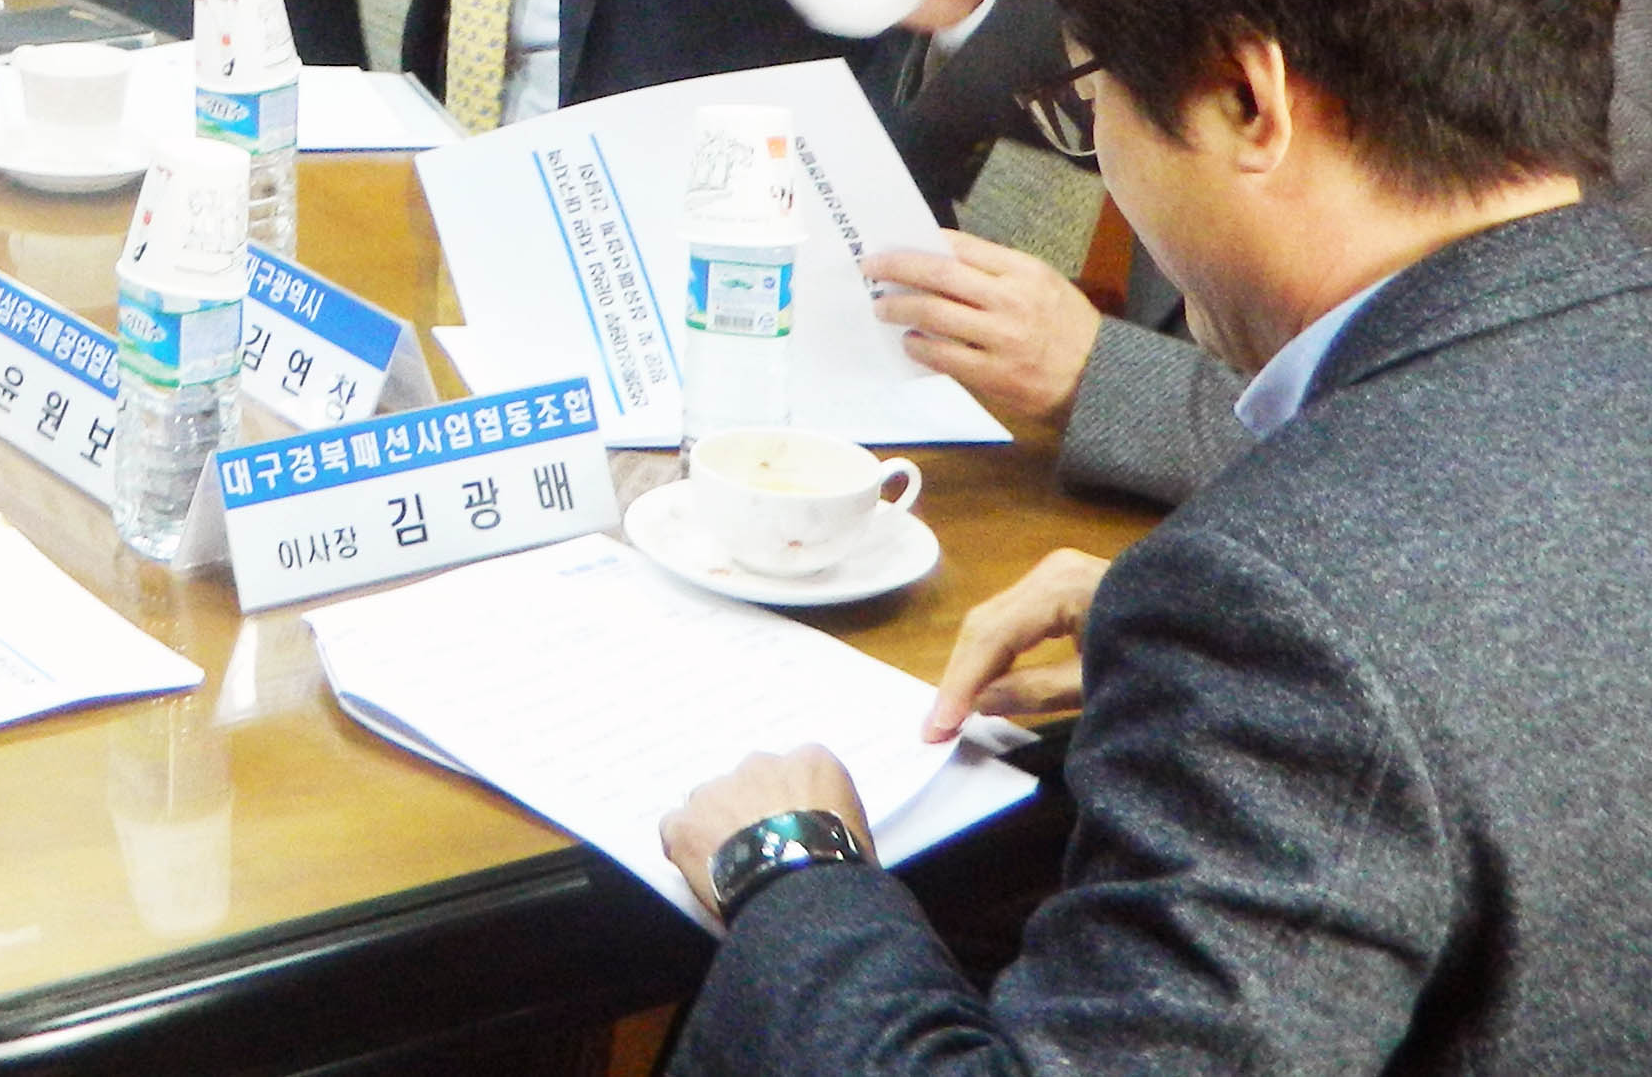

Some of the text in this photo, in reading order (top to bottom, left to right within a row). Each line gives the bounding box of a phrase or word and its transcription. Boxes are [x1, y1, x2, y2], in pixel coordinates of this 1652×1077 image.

[242, 324, 271, 371] 김
[36, 390, 70, 441] 원
[79, 417, 116, 467] 보
[278, 461, 575, 571] 이사장 김 광 배
